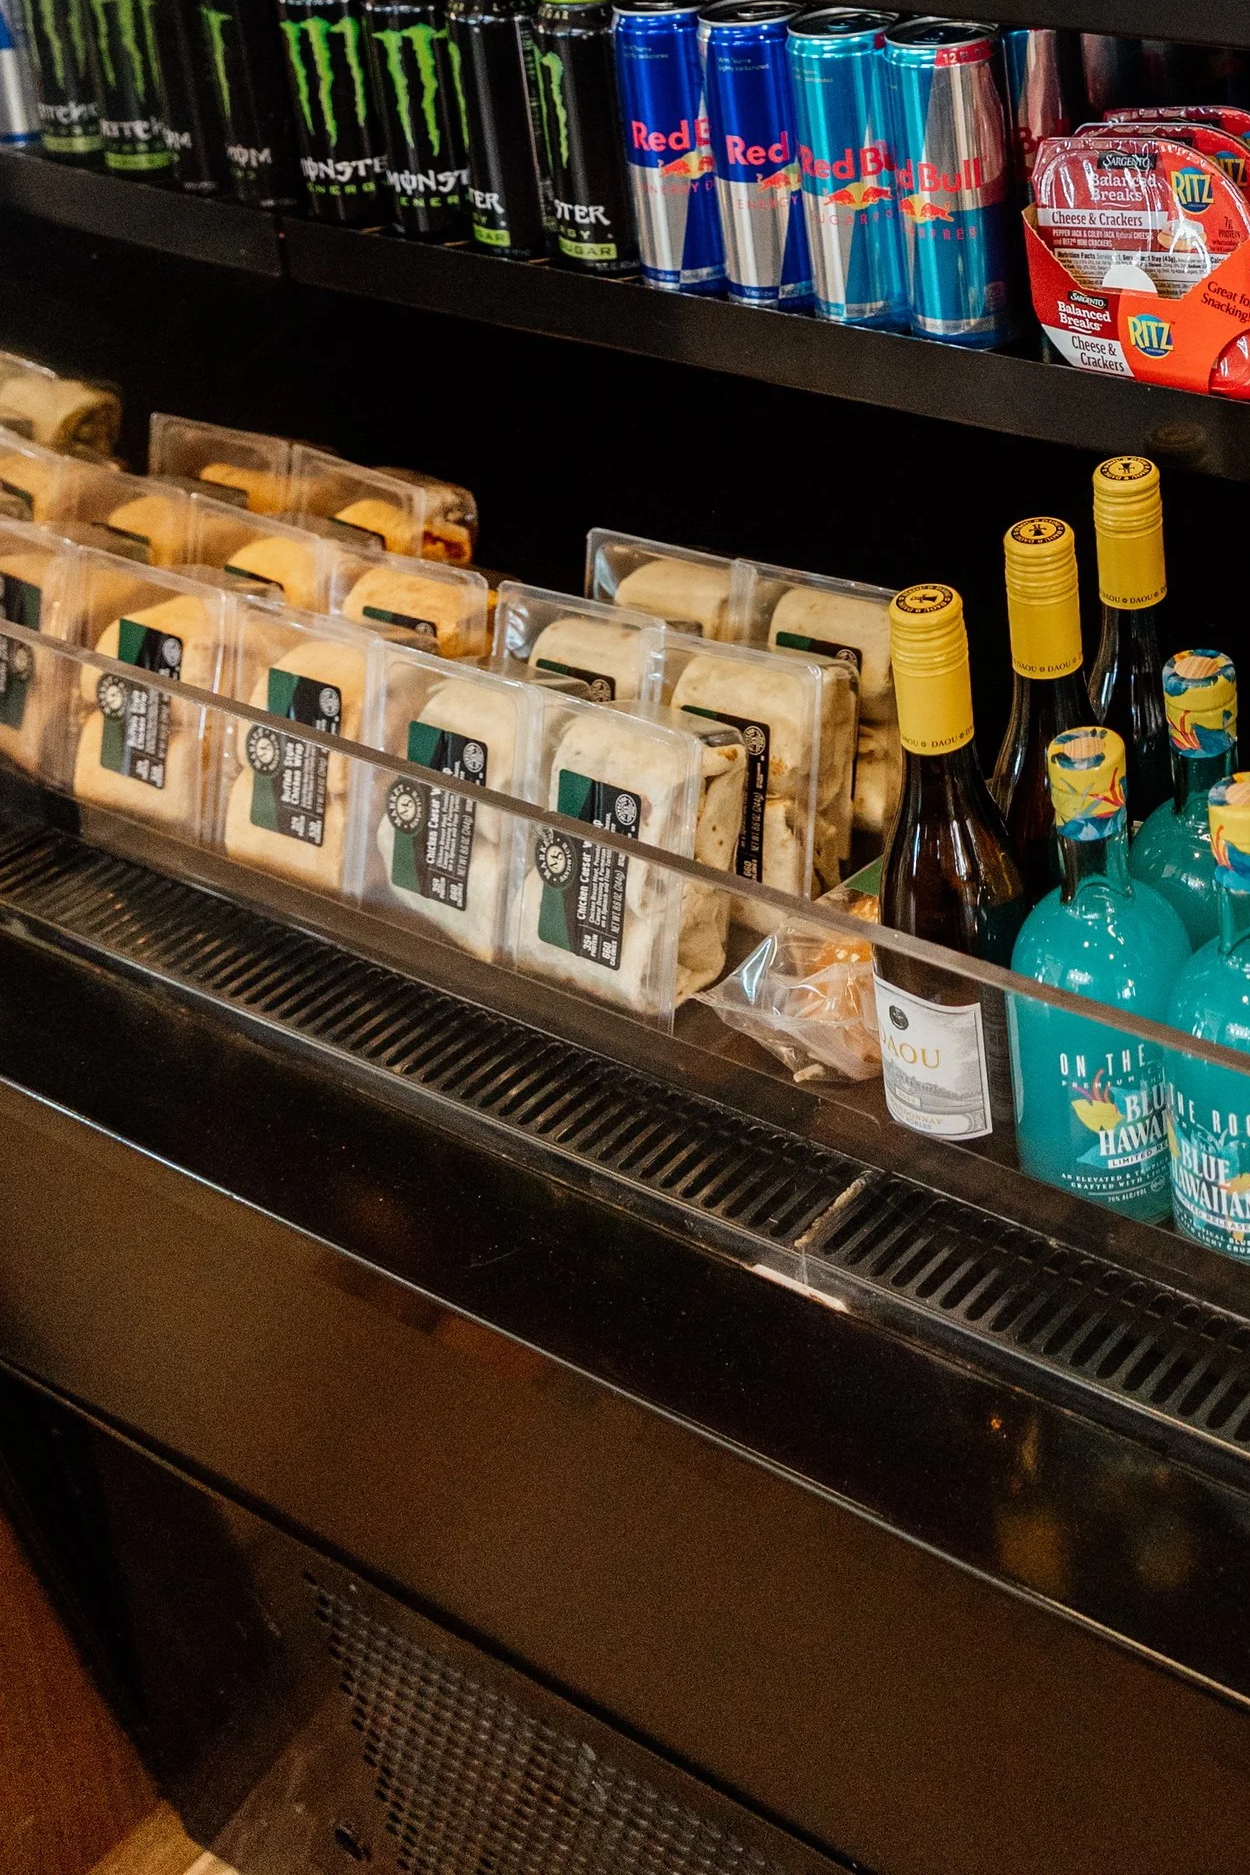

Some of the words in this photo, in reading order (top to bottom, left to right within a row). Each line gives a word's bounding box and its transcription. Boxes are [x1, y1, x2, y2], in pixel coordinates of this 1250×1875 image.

[942, 51, 957, 64] 12
[631, 119, 691, 152] Red
[725, 131, 790, 166] Red
[801, 145, 855, 179] Red
[918, 158, 982, 194] Bull
[1170, 170, 1215, 205] RITZ
[1207, 280, 1239, 304] Great
[1057, 300, 1111, 322] Balanced
[1059, 313, 1100, 332] Breaks
[1080, 351, 1125, 373] Crackers
[1047, 661, 1072, 673] DAOU
[931, 735, 959, 749] DAOU
[580, 852, 592, 884] Caesar
[577, 885, 590, 921] Chicken
[1059, 1052, 1087, 1078] ON
[1106, 1043, 1146, 1077] THE
[1111, 1149, 1154, 1168] LIMITED
[1181, 1139, 1231, 1185] BLUE
[1206, 1210, 1250, 1231] RELEASE
